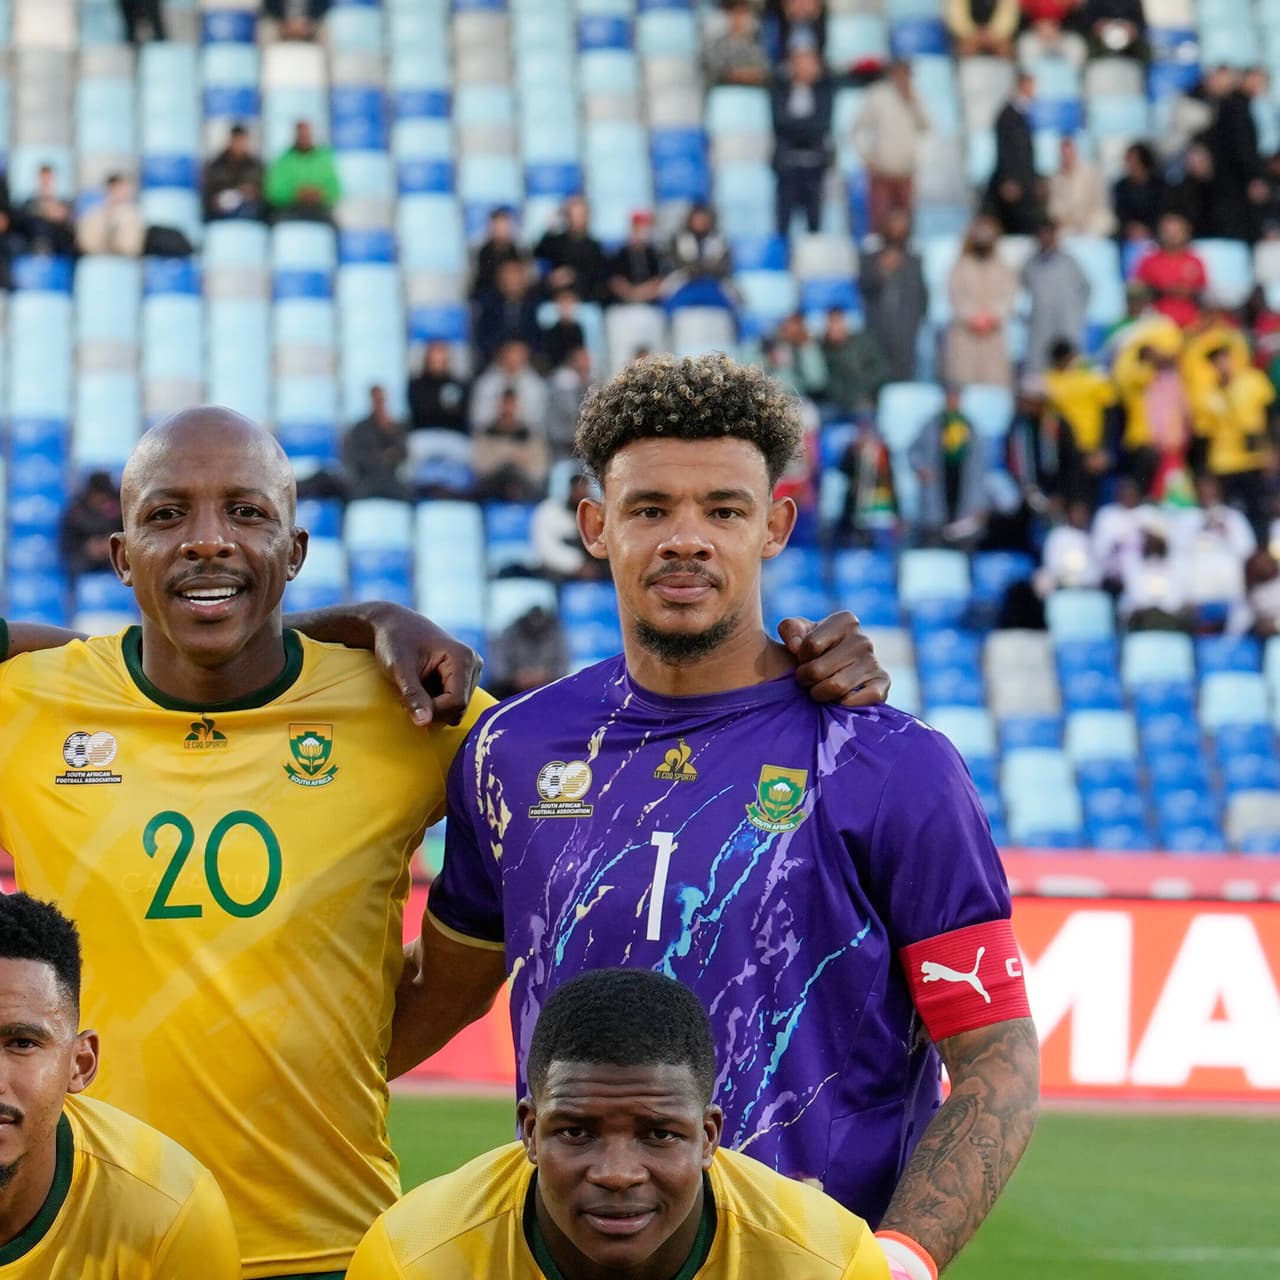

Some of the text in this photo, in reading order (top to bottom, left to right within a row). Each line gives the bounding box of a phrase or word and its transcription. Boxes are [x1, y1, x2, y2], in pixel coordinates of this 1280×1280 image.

[290, 775, 332, 786] SOUTH AFRICA
[653, 770, 660, 779] LE
[674, 773, 698, 782] SPORTIF
[752, 816, 796, 830] SOUTH AFRICA
[144, 811, 281, 918] 20
[647, 832, 678, 940] 1
